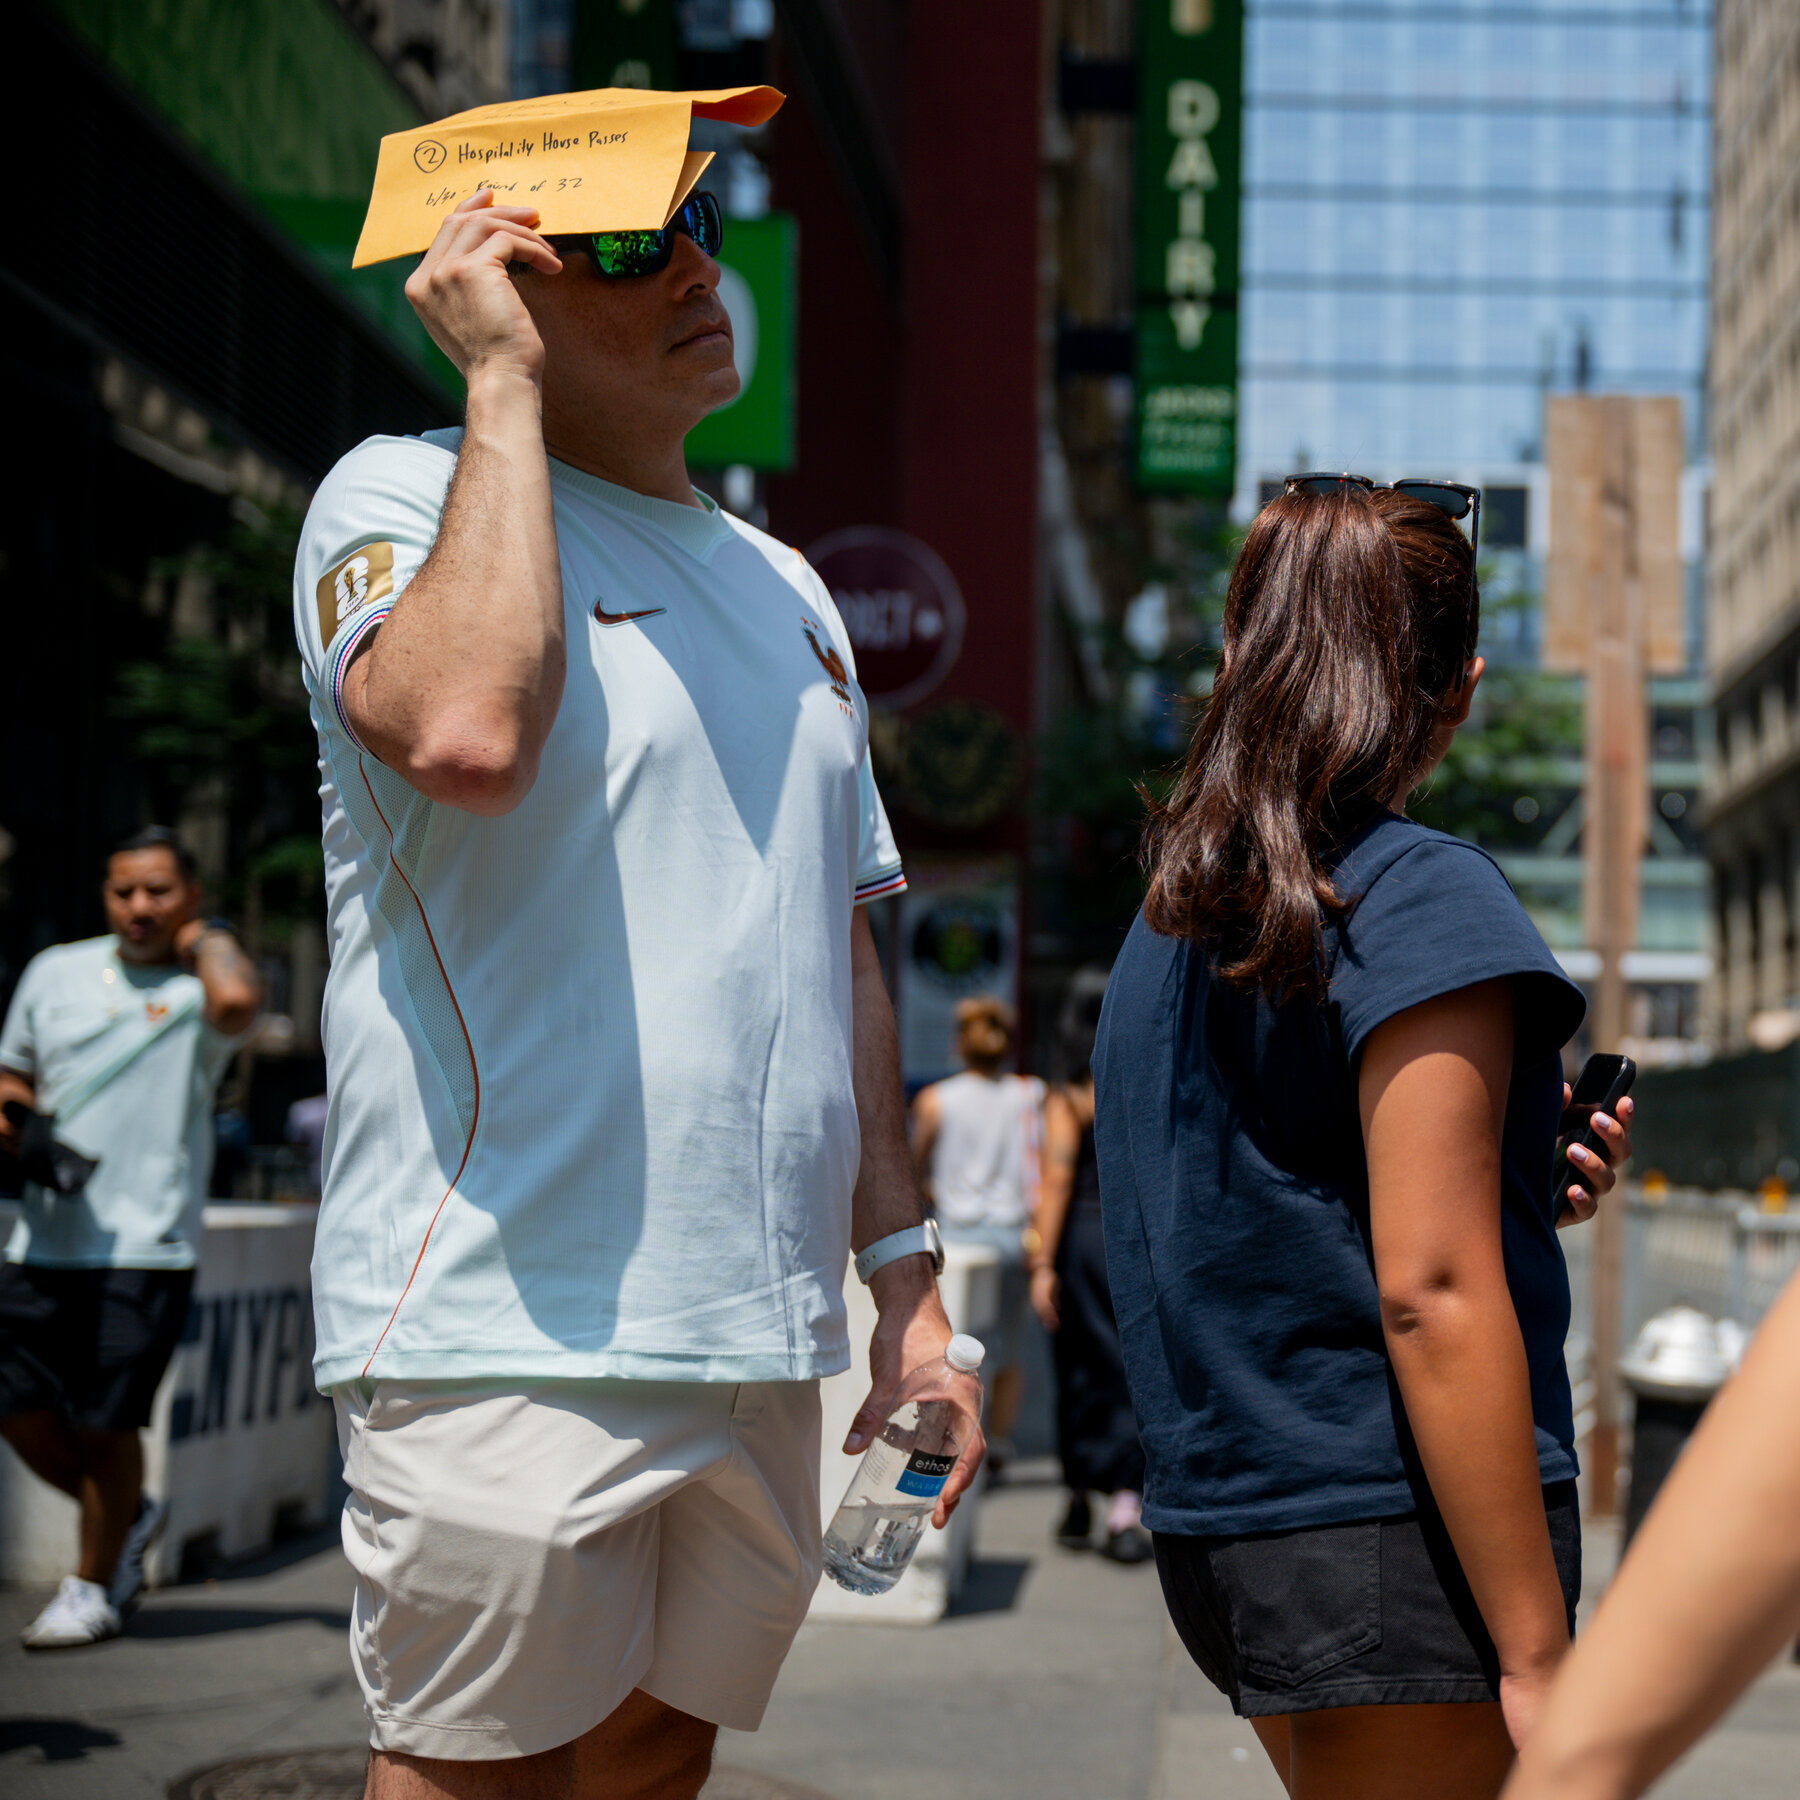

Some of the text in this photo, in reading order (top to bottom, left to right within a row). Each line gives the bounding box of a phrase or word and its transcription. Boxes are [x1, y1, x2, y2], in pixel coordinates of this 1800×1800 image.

[458, 139, 534, 164] Hospitality
[543, 132, 580, 152] House
[589, 131, 628, 148] Passes
[530, 180, 547, 192] of
[556, 177, 582, 192] 32
[915, 1459, 951, 1472] ethos
